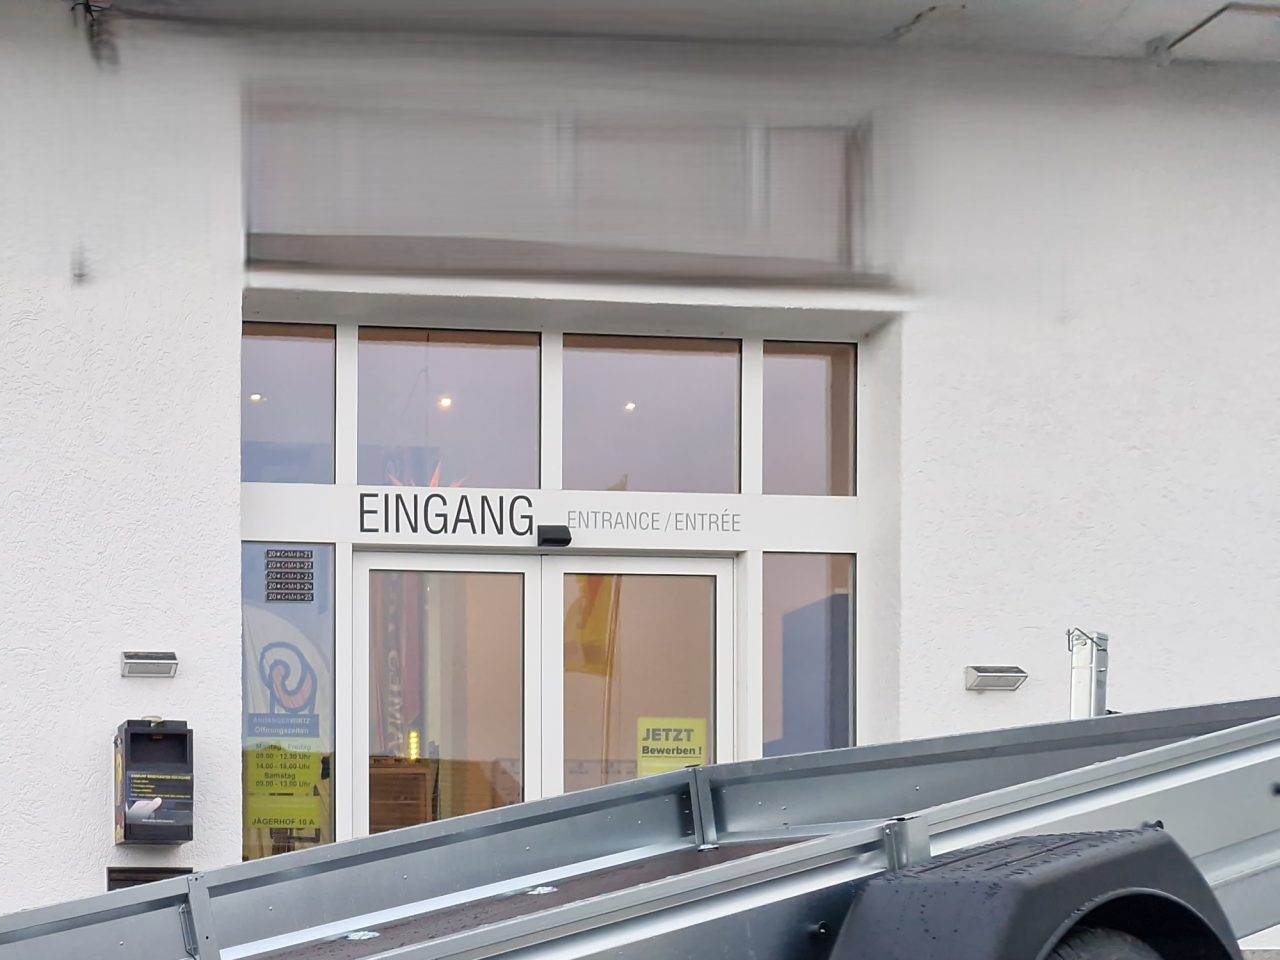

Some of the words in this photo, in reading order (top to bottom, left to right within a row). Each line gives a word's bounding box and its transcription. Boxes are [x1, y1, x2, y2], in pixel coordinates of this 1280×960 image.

[359, 492, 534, 537] EINGANG
[641, 727, 695, 742] JETZT
[641, 745, 696, 755] Bewerben
